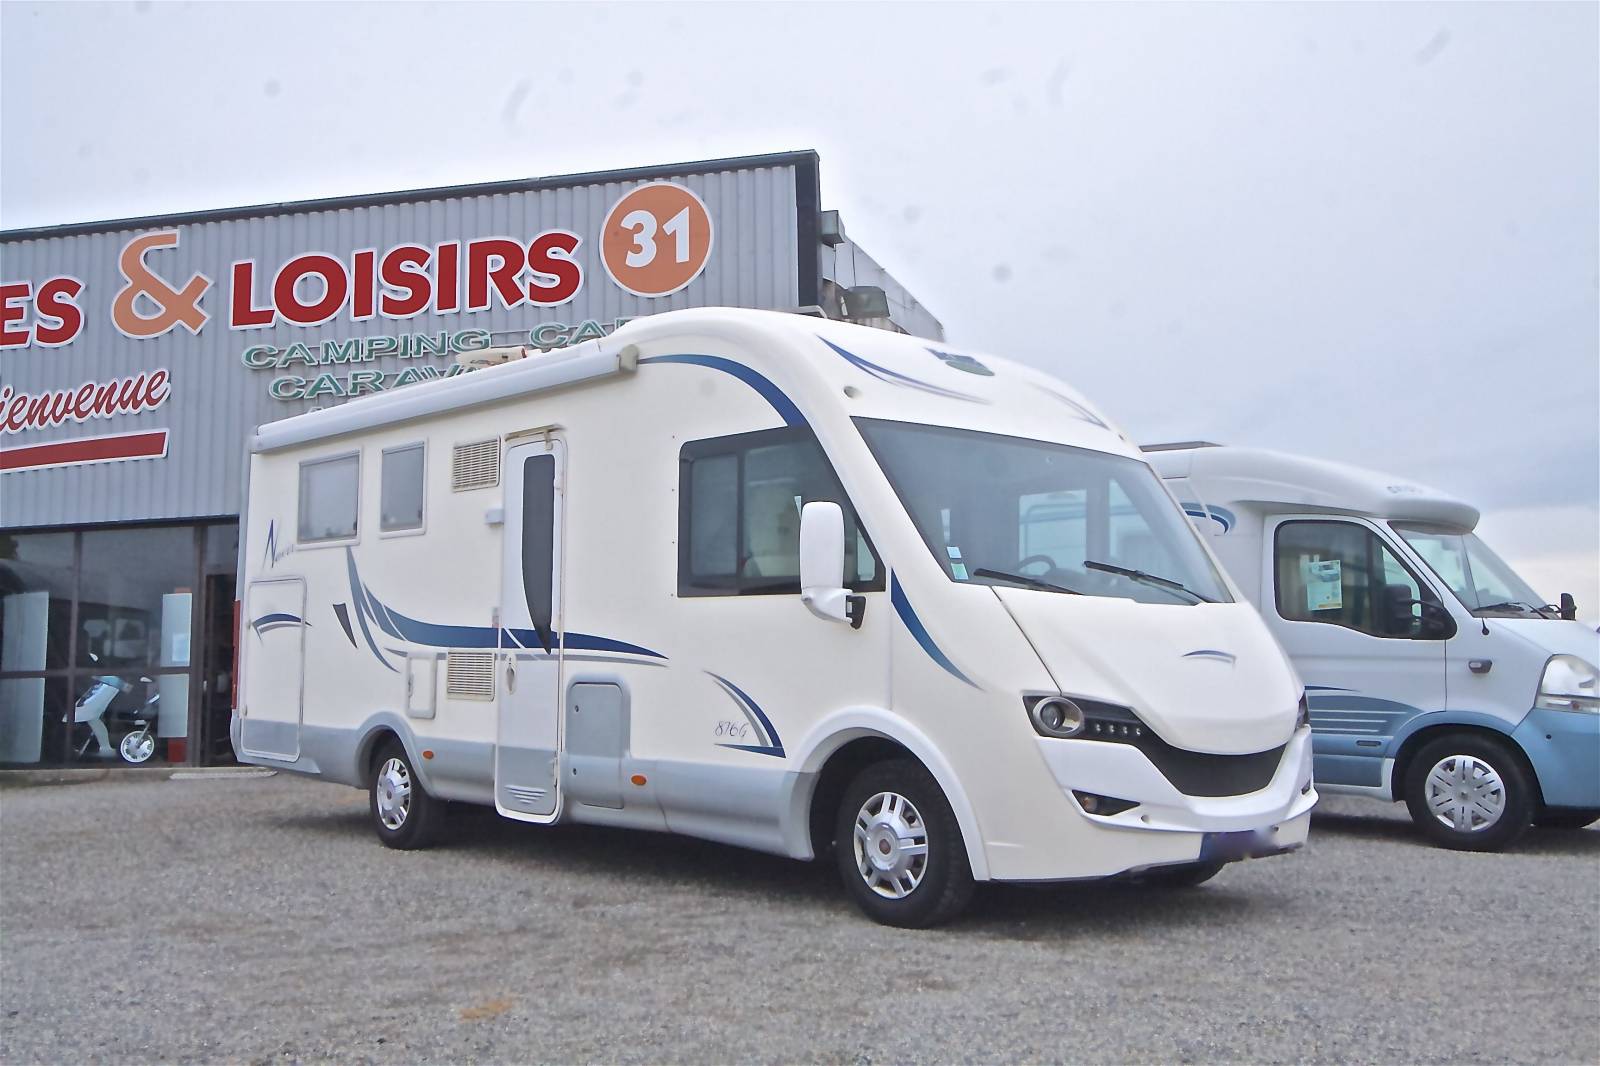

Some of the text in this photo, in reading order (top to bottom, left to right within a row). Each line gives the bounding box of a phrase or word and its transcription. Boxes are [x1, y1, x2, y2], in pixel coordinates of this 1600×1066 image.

[111, 230, 213, 338] &
[229, 230, 583, 330] LOISIRS
[620, 206, 689, 268] 31
[242, 328, 491, 370] CAMPING
